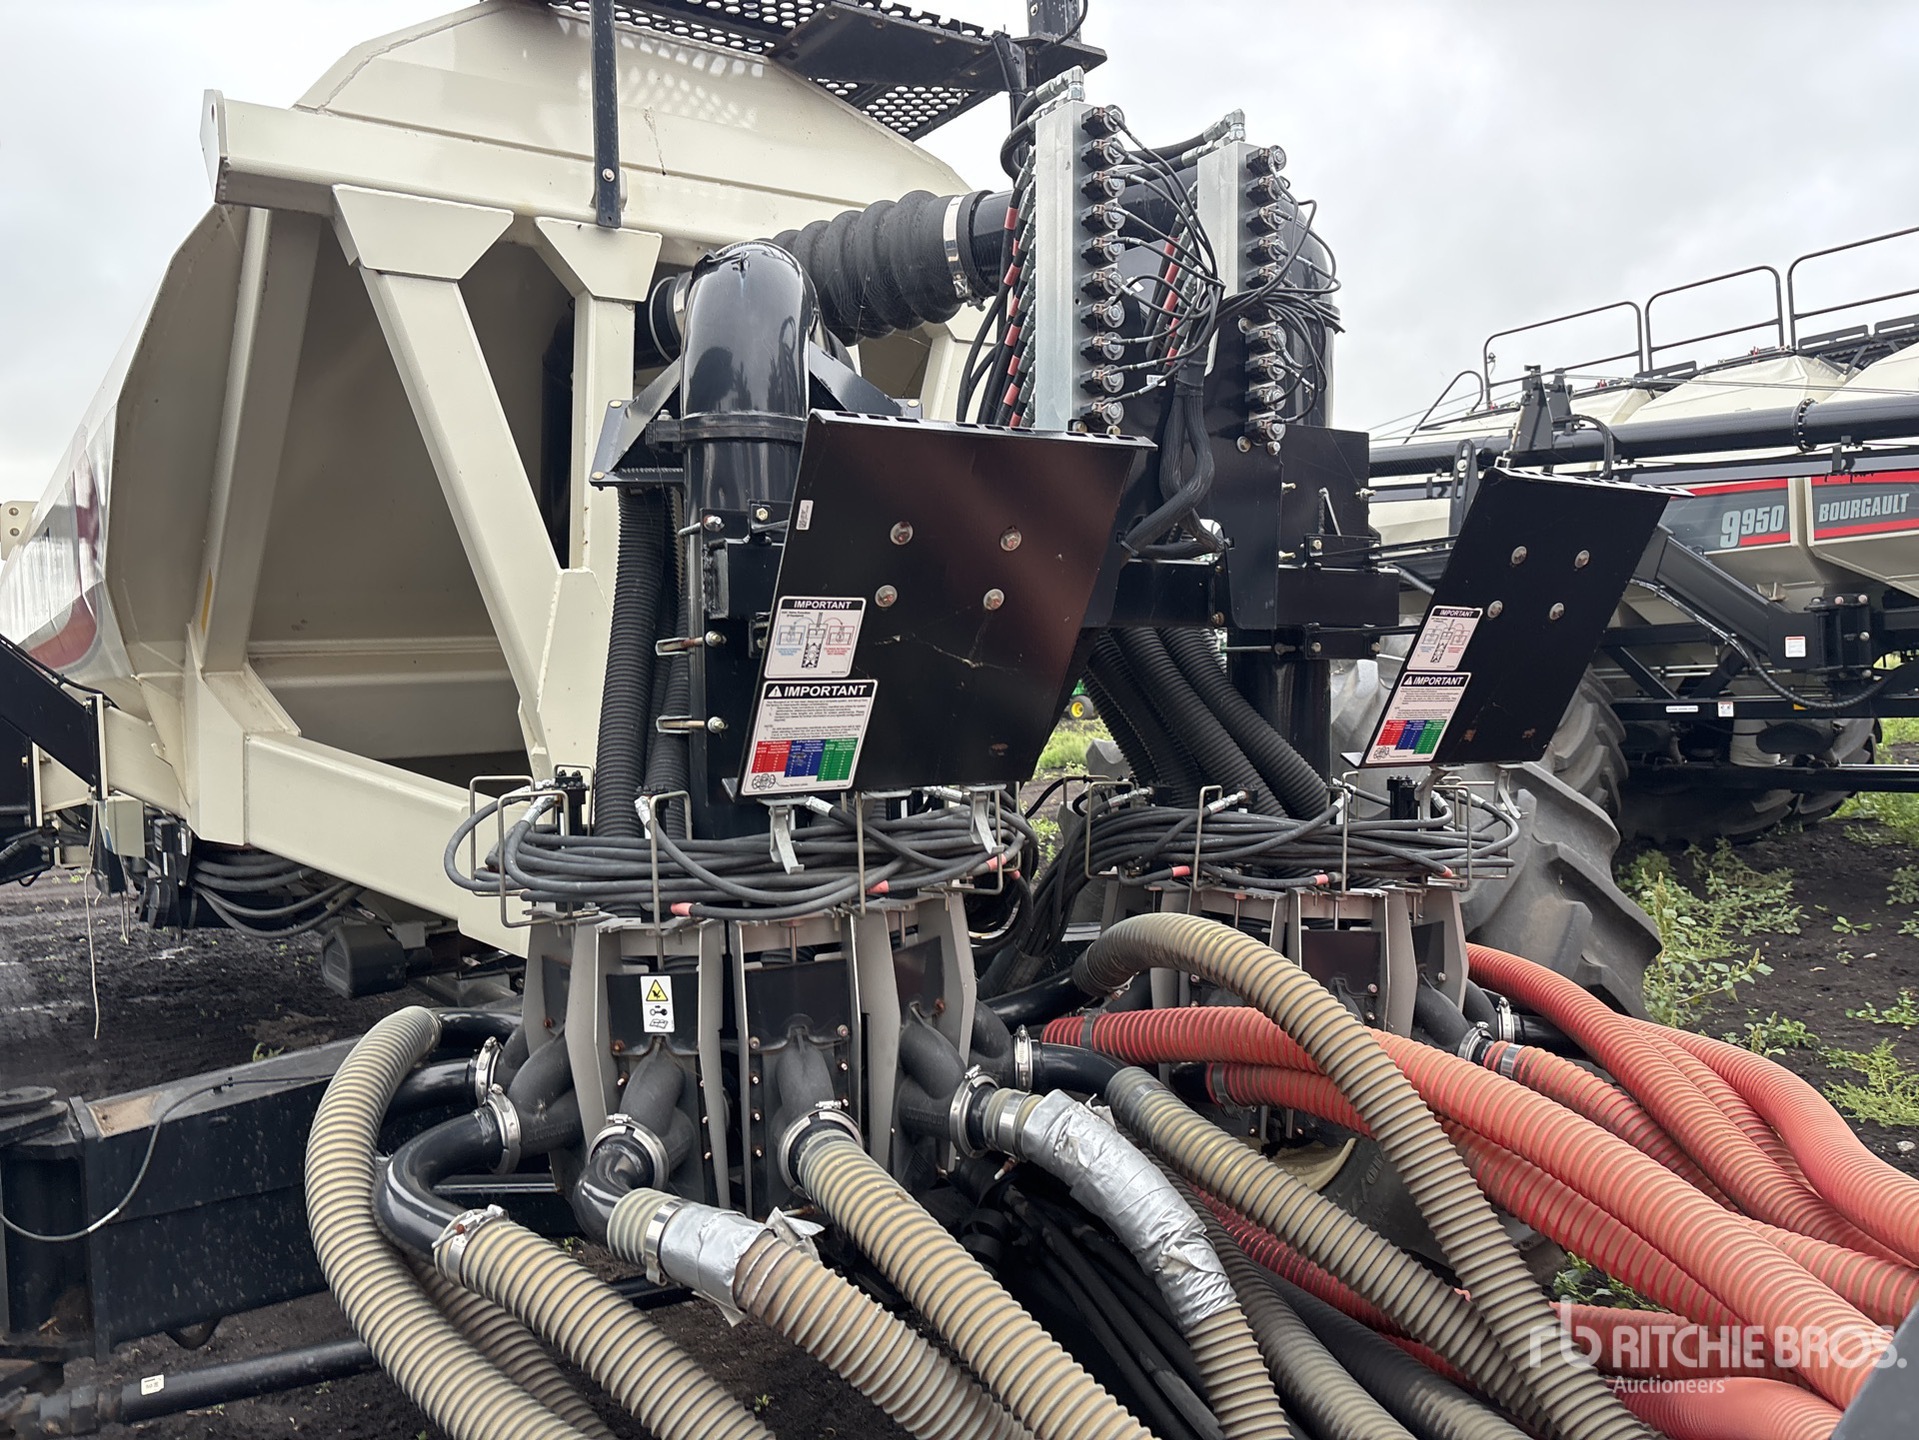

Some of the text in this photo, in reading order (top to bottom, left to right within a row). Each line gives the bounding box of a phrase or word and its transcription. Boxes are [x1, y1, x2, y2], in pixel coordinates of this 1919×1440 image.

[1818, 493, 1909, 523] BOURGAULT
[1719, 504, 1785, 548] 9950
[793, 600, 853, 609] IMPORTANT
[1439, 609, 1475, 618] IMPORTANT
[1412, 676, 1465, 686] IMPORTANT
[784, 685, 867, 697] IMPORTANT
